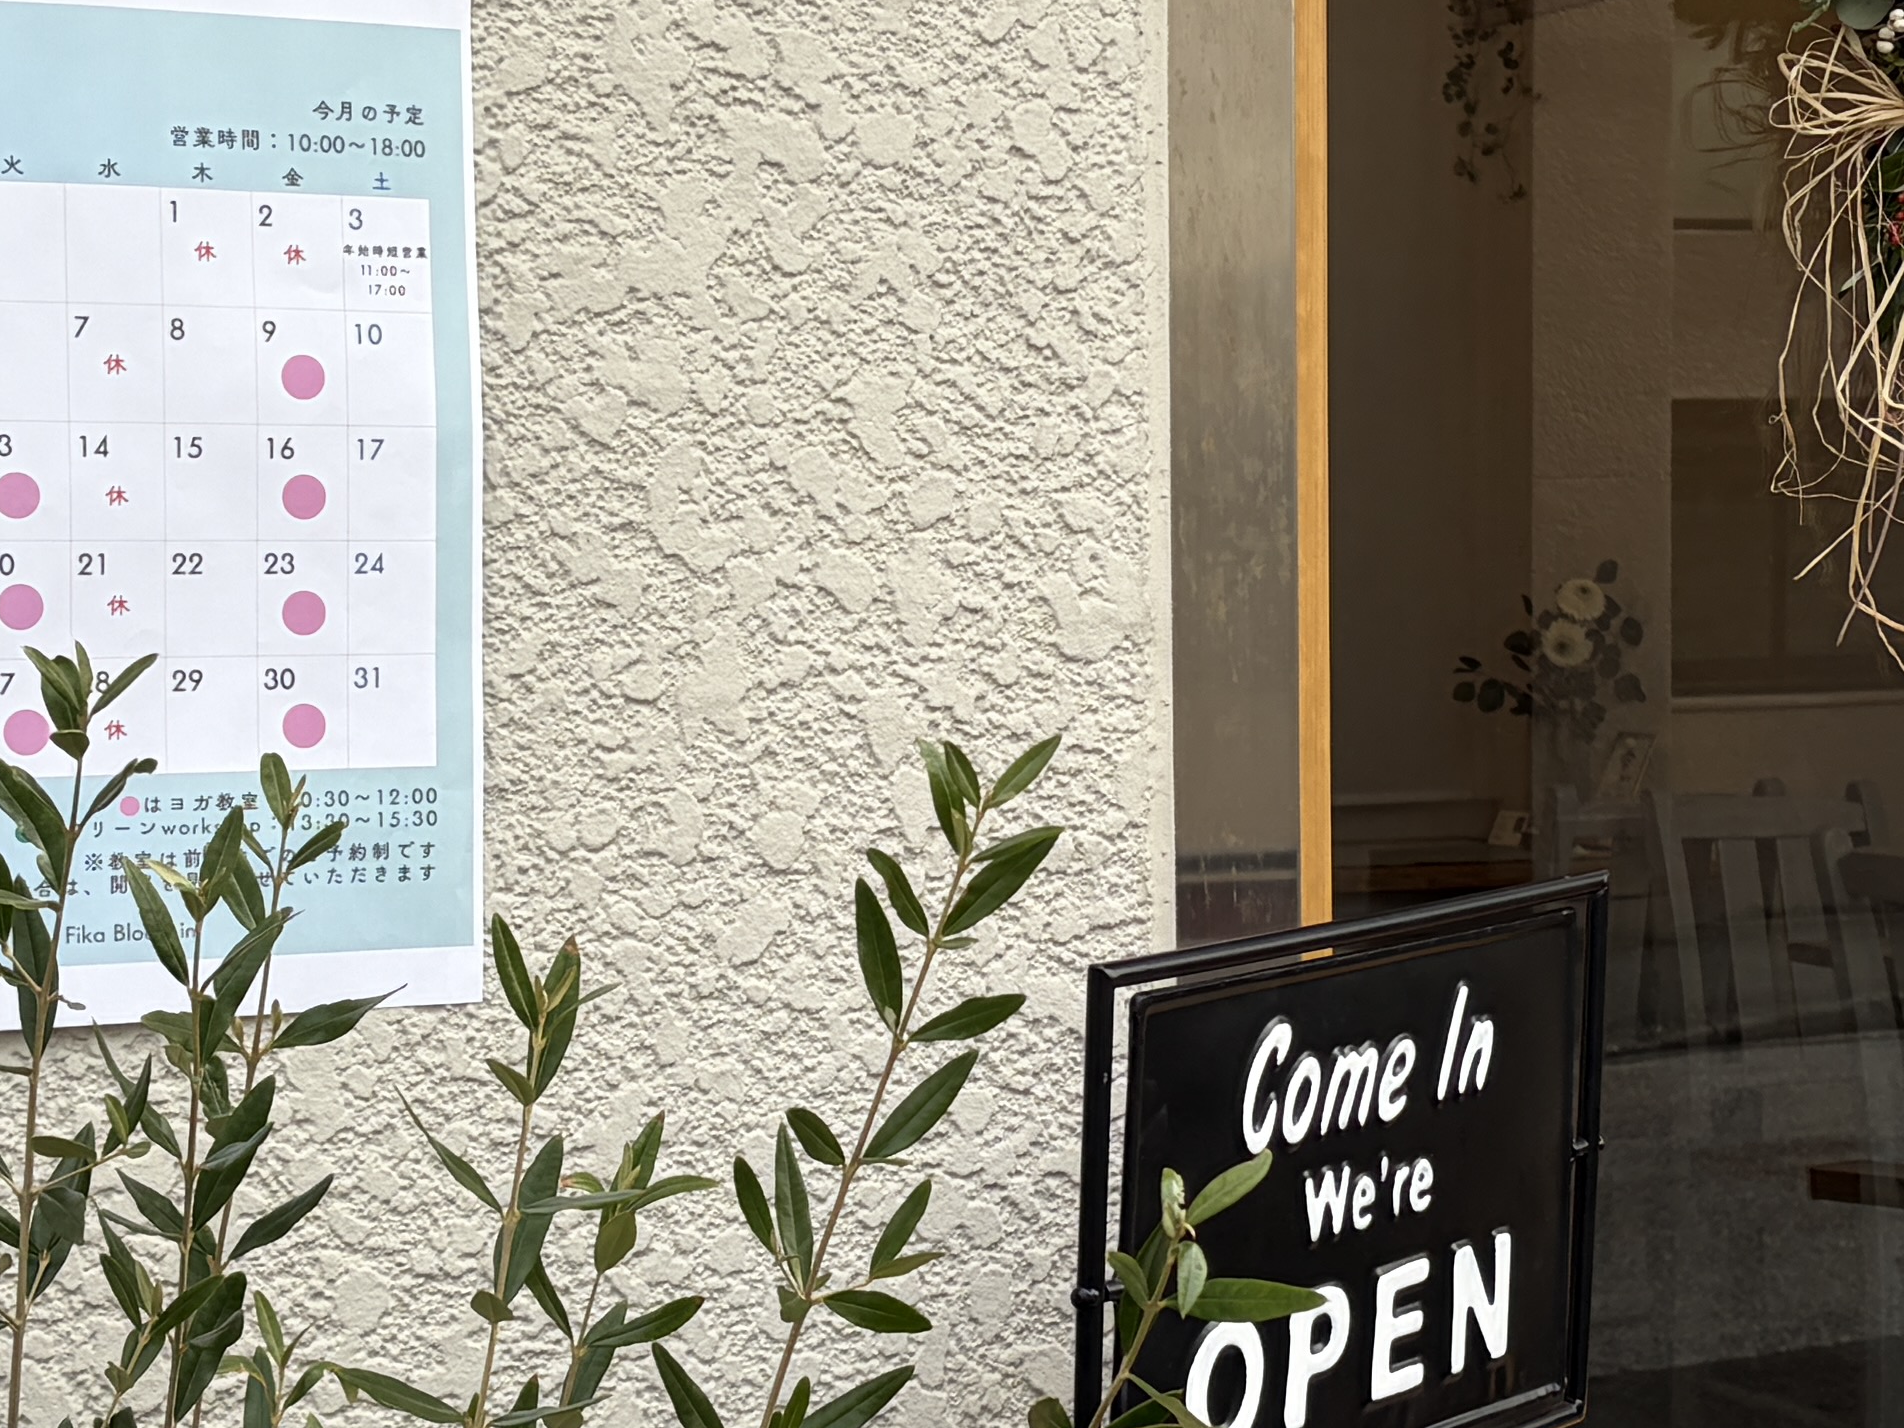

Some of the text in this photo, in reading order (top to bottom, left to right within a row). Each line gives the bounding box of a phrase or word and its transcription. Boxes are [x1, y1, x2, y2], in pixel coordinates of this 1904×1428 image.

[311, 99, 425, 127] 今月の予定
[0, 154, 25, 176] 火
[97, 157, 122, 179] 水
[191, 161, 214, 184] 木
[281, 166, 305, 188] 金
[371, 171, 392, 191] 土
[169, 199, 364, 231] 1 2 3
[193, 240, 307, 266] 休 休
[368, 285, 406, 298] 17:00
[73, 315, 90, 339] 7
[169, 317, 186, 341] 8
[261, 320, 277, 343] 9
[354, 323, 383, 346] 10
[102, 353, 128, 376] 休
[78, 434, 110, 459] 14
[173, 435, 203, 459] 15
[266, 436, 296, 461] 16
[356, 438, 385, 461] 17
[104, 485, 130, 507] 休
[76, 552, 106, 577] 21
[171, 552, 204, 576] 22
[263, 552, 296, 575] 23
[353, 552, 385, 575] 24
[106, 594, 131, 617] 休
[171, 668, 204, 693] 29
[263, 667, 296, 691] 30
[353, 666, 380, 690] 31
[103, 719, 128, 741] 休
[66, 925, 105, 944] Fika
[1242, 982, 1494, 1154] Come In
[1305, 1155, 1432, 1242] We're
